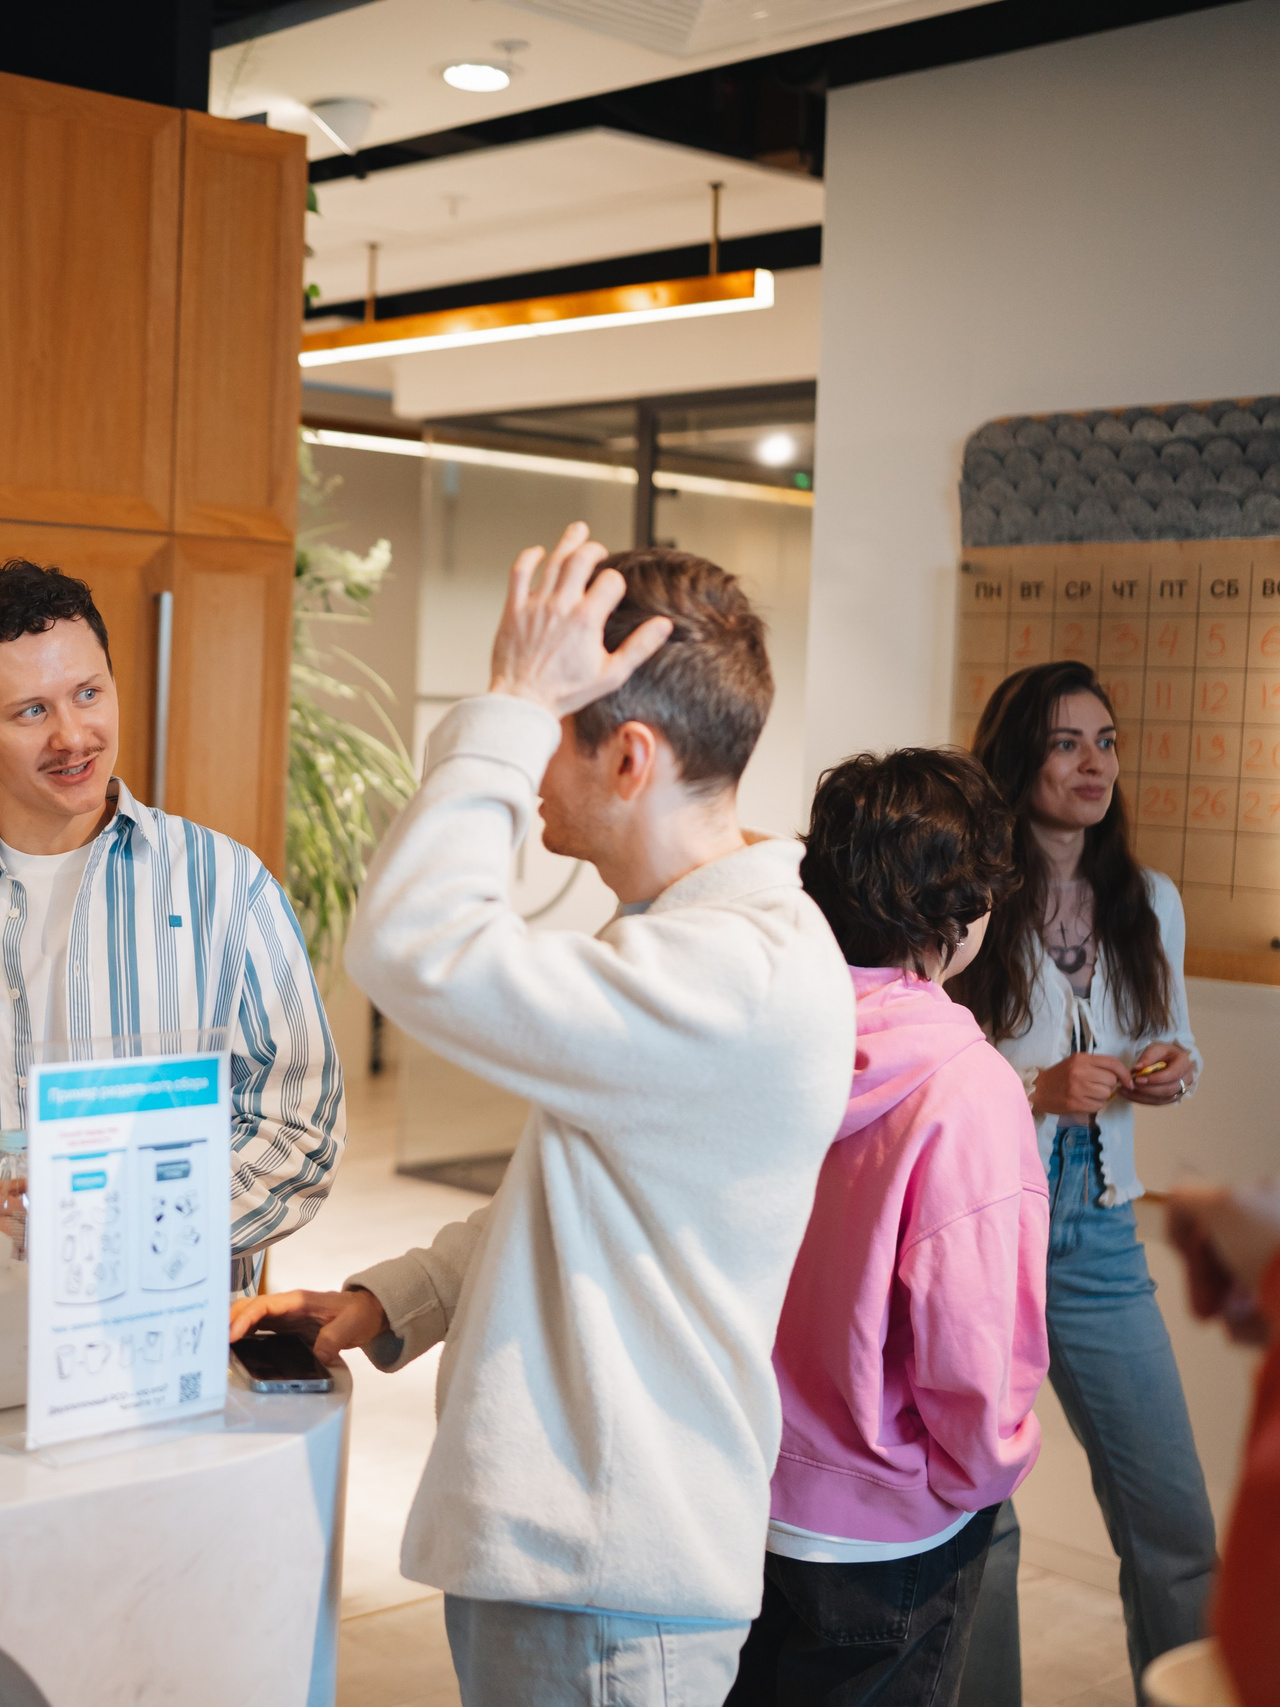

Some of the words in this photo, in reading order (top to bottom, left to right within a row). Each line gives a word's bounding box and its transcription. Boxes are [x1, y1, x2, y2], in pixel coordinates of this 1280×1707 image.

[975, 581, 1002, 600] ПН
[1020, 581, 1044, 600] ВТ
[1064, 580, 1091, 600] СР
[1112, 579, 1138, 599] ЧТ
[1160, 579, 1188, 599] ПТ
[1210, 578, 1239, 599] СБ
[1262, 578, 1280, 599] В
[1014, 624, 1036, 657] 1
[1064, 622, 1084, 658] 2
[1109, 622, 1139, 658] 3
[1158, 621, 1179, 659] 4
[1205, 623, 1226, 659] 5
[1260, 624, 1280, 658] 6
[1155, 681, 1172, 710] 11
[1201, 680, 1229, 713] 12
[1147, 732, 1171, 761] 18
[1195, 733, 1226, 763] 19
[1143, 785, 1178, 817] 25
[1191, 785, 1228, 820] 26
